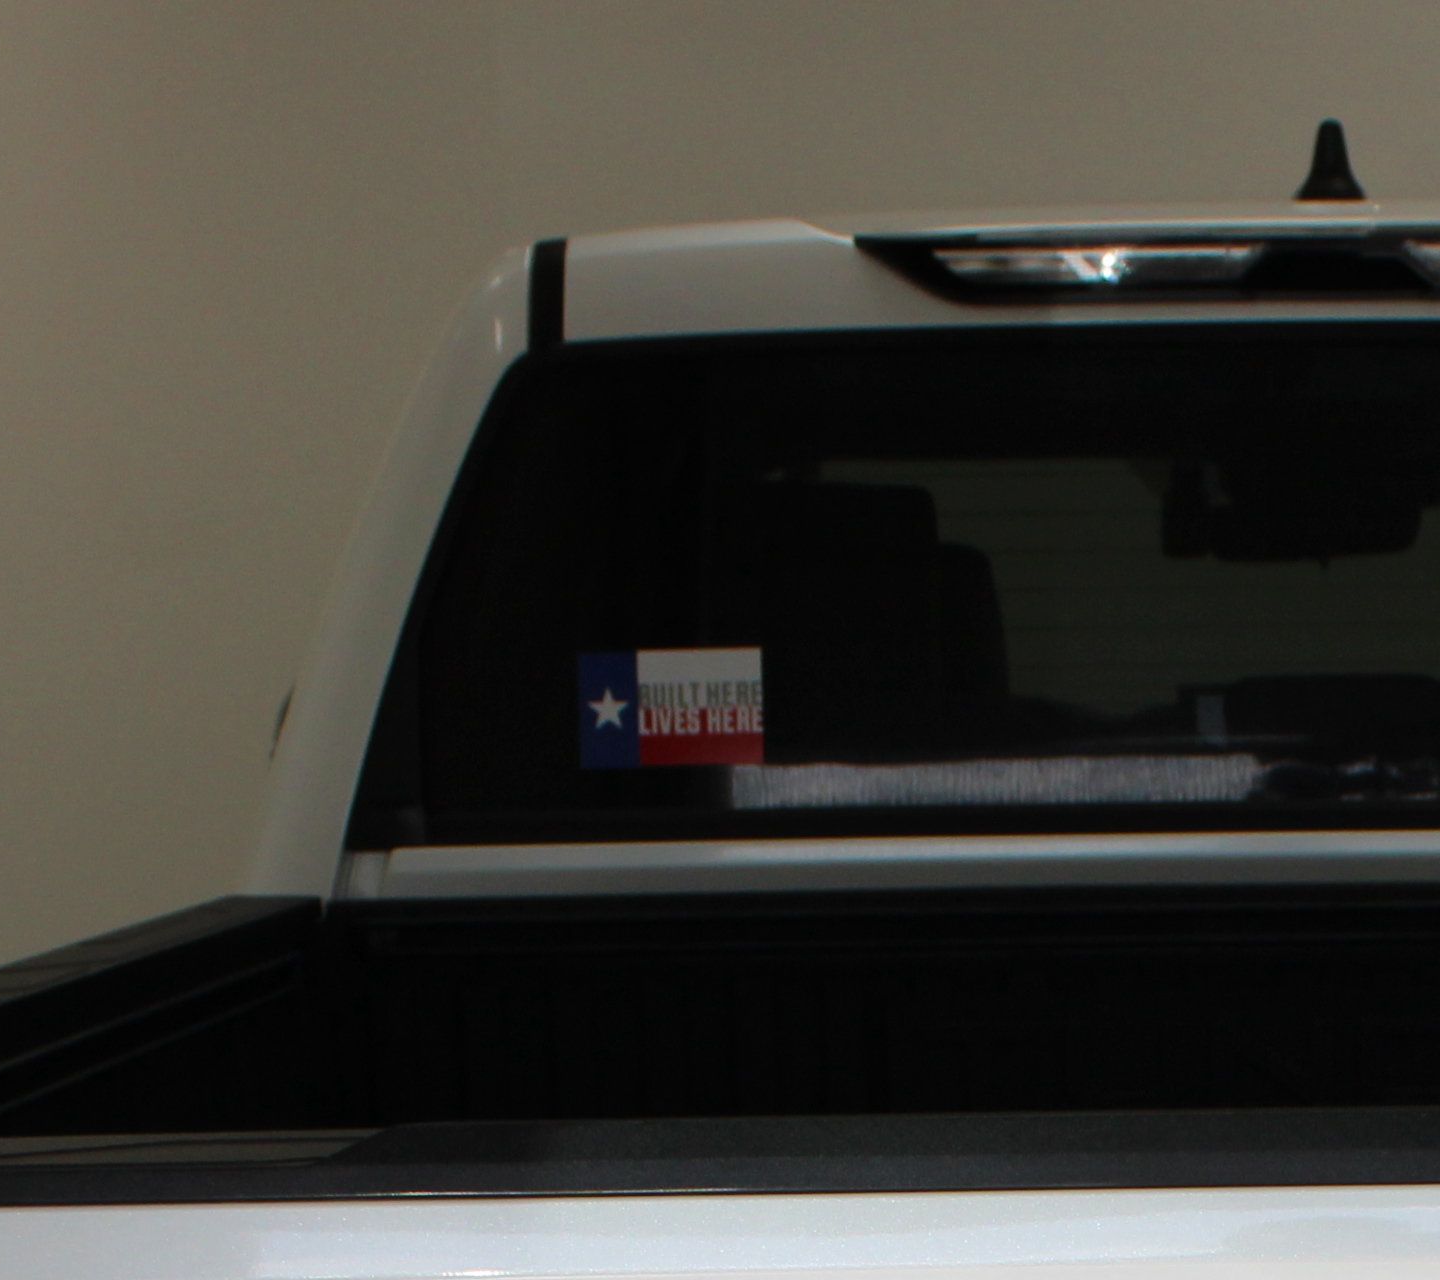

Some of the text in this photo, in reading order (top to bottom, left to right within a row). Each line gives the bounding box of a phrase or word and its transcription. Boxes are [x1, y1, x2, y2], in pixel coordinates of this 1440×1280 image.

[639, 680, 761, 708] BUILT HERE
[638, 704, 764, 735] LIVES HERE
